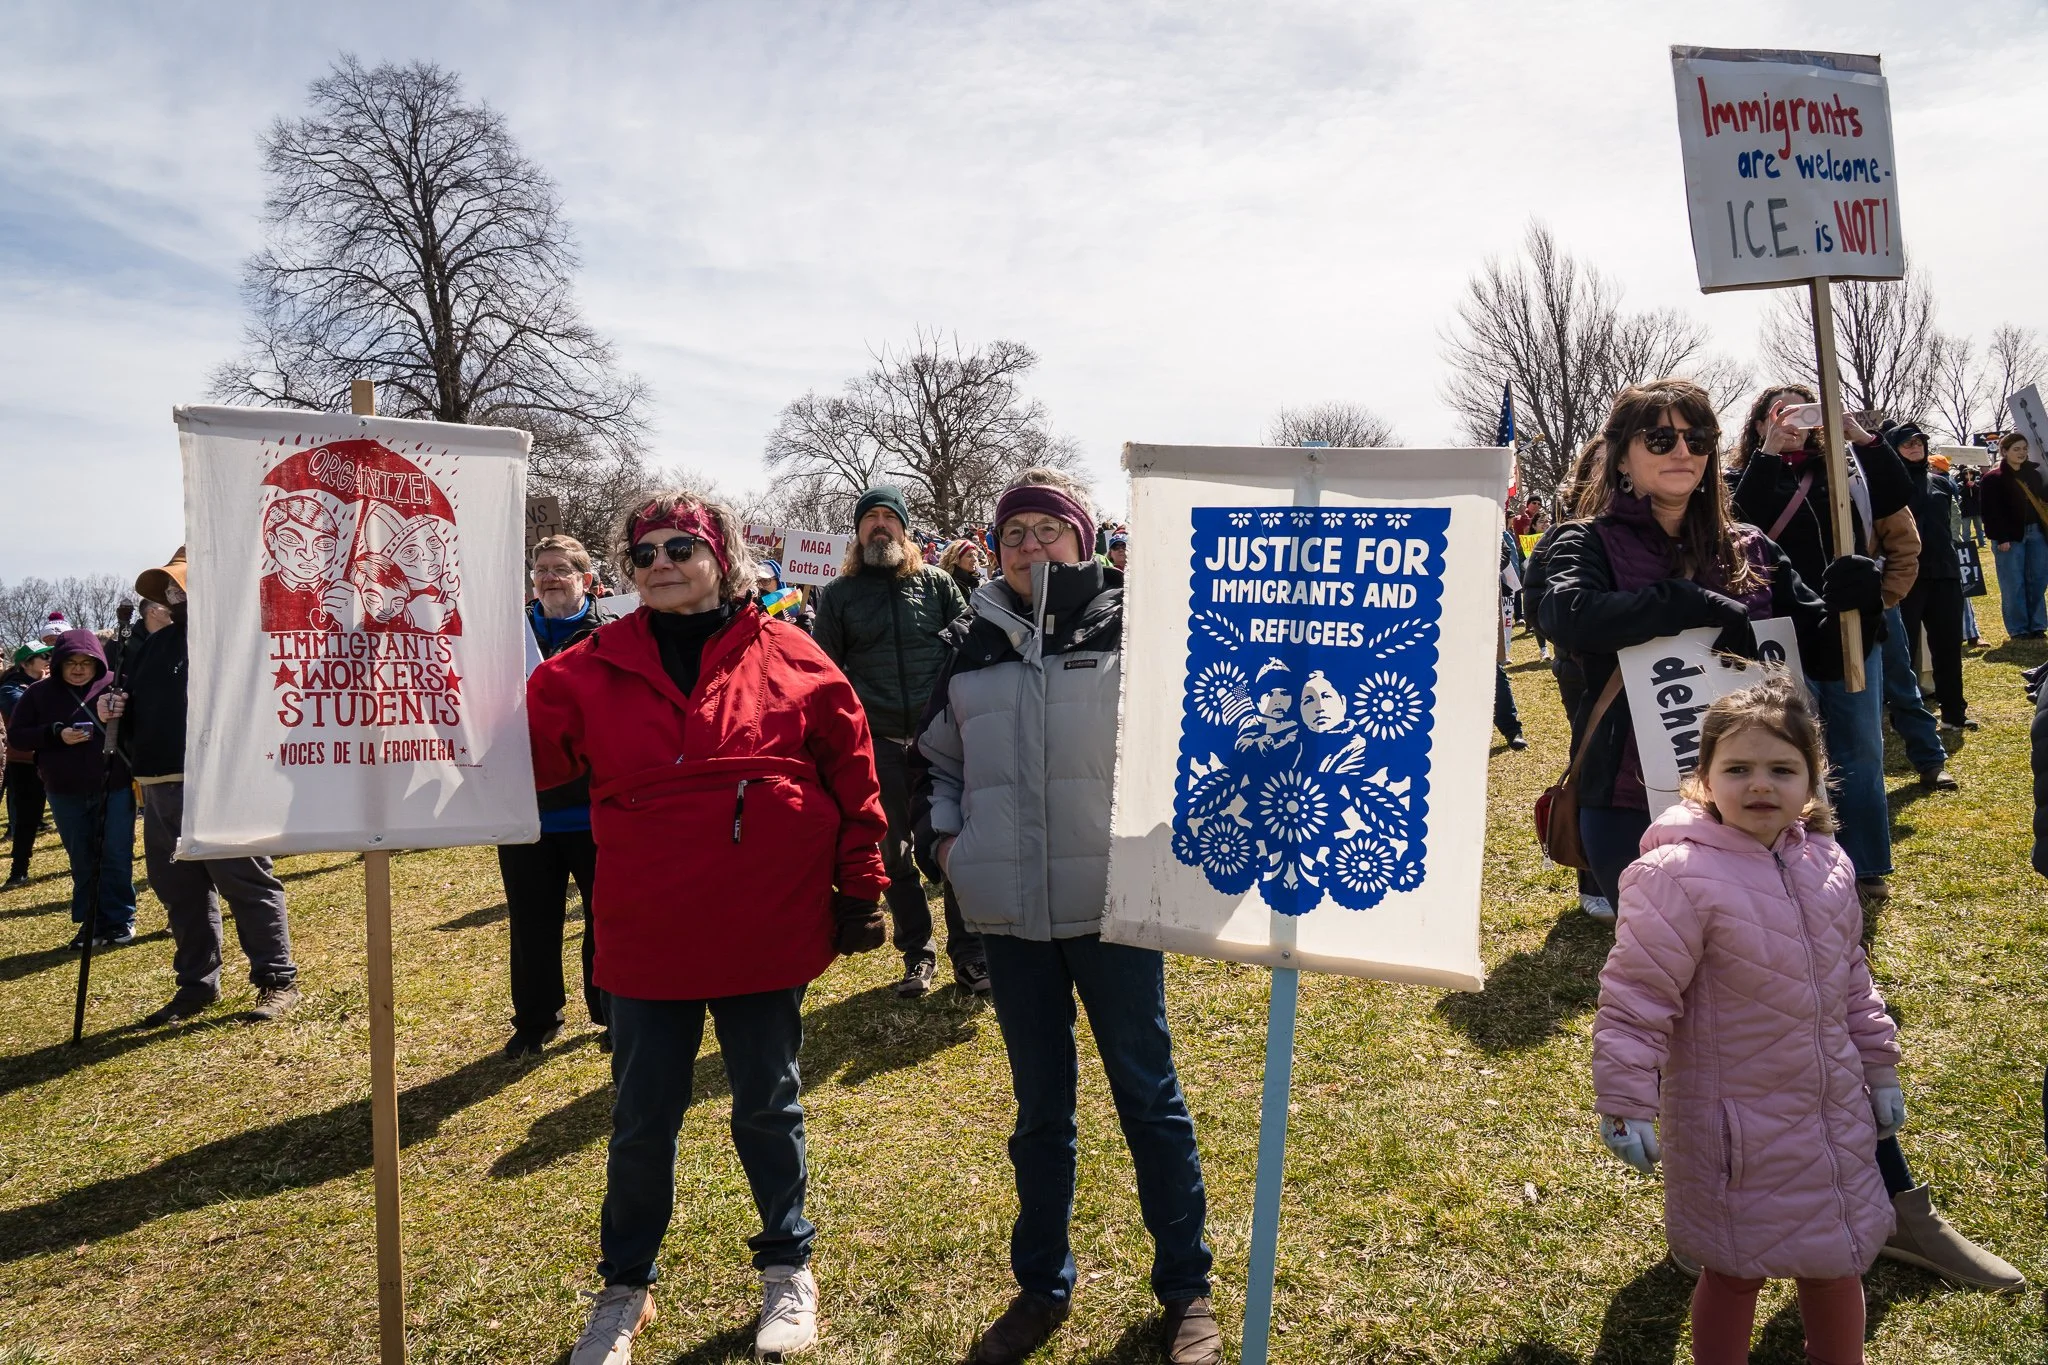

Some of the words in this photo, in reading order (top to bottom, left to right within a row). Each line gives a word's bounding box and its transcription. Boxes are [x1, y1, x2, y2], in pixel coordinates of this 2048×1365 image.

[1697, 76, 1863, 160] Immigrants
[1738, 149, 1781, 179] are
[1727, 198, 1807, 259] I.C.E.
[1815, 220, 1834, 254] is
[1833, 198, 1890, 256] NOT!
[308, 447, 432, 506] ORGANIZE!
[743, 525, 783, 548] Humanity
[801, 538, 832, 555] MAGA
[789, 560, 819, 575] Gotta
[823, 563, 837, 577] Go
[1205, 536, 1343, 574] JUSTICE
[1355, 537, 1430, 576] FOR
[1211, 578, 1356, 608] IMMIGRANTS
[1362, 582, 1418, 609] AND
[270, 631, 453, 664] IMMIGRANTS
[1250, 618, 1365, 648] REFUGEES
[300, 659, 444, 693] WORKERS
[277, 690, 461, 728] STUDENTS
[279, 741, 326, 767] VOCES
[333, 741, 352, 765] DE
[359, 741, 376, 766] LA
[383, 738, 456, 764] FRONTERA
